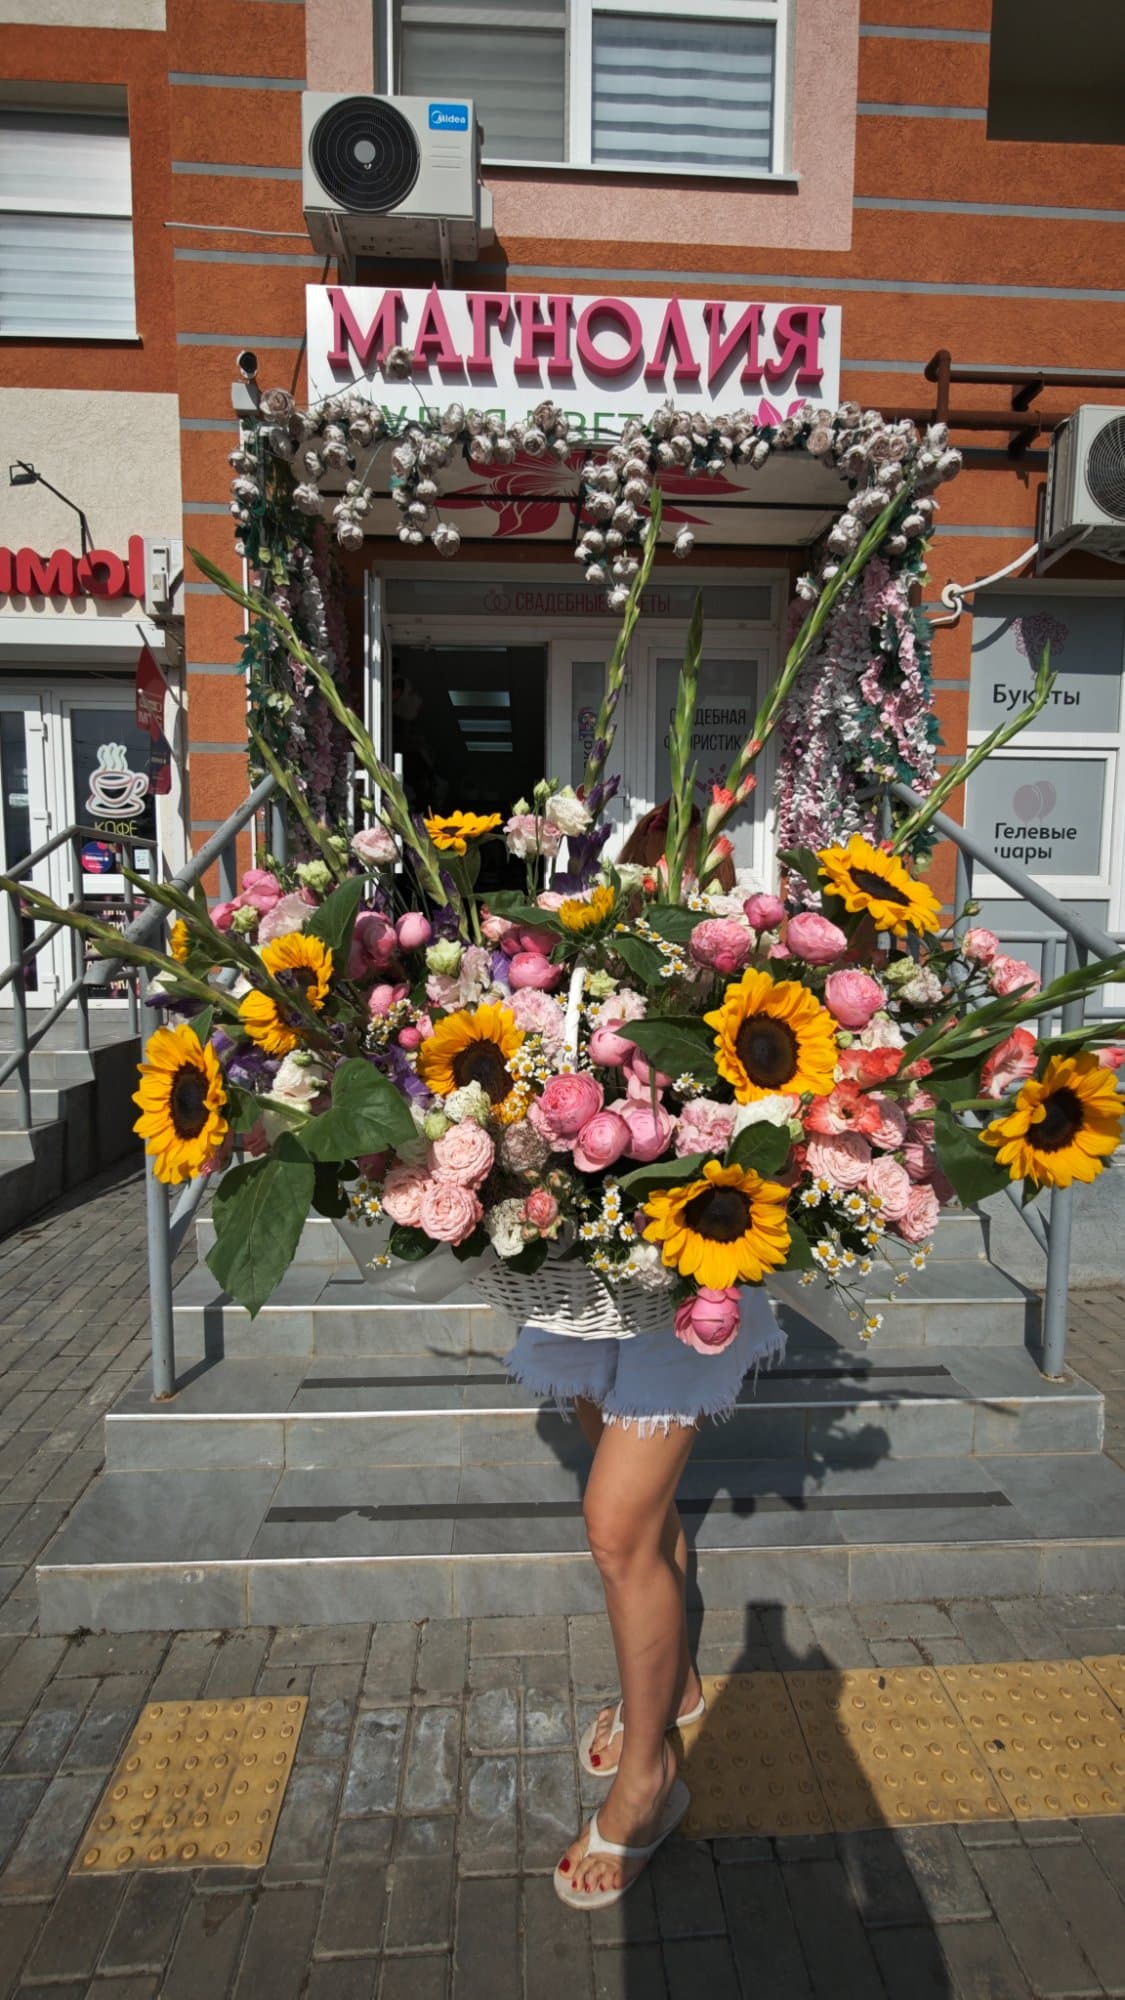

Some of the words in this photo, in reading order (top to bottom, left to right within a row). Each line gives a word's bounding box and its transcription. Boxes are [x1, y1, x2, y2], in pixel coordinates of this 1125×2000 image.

[431, 110, 467, 124] Midea
[326, 282, 827, 388] МАГНОЛИЯ
[993, 684, 1080, 711] Букты
[669, 707, 746, 726] СДЕБНАЯ
[94, 820, 138, 838] КОФЕ
[994, 822, 1077, 840] Гелевые
[994, 846, 1052, 865] шары
